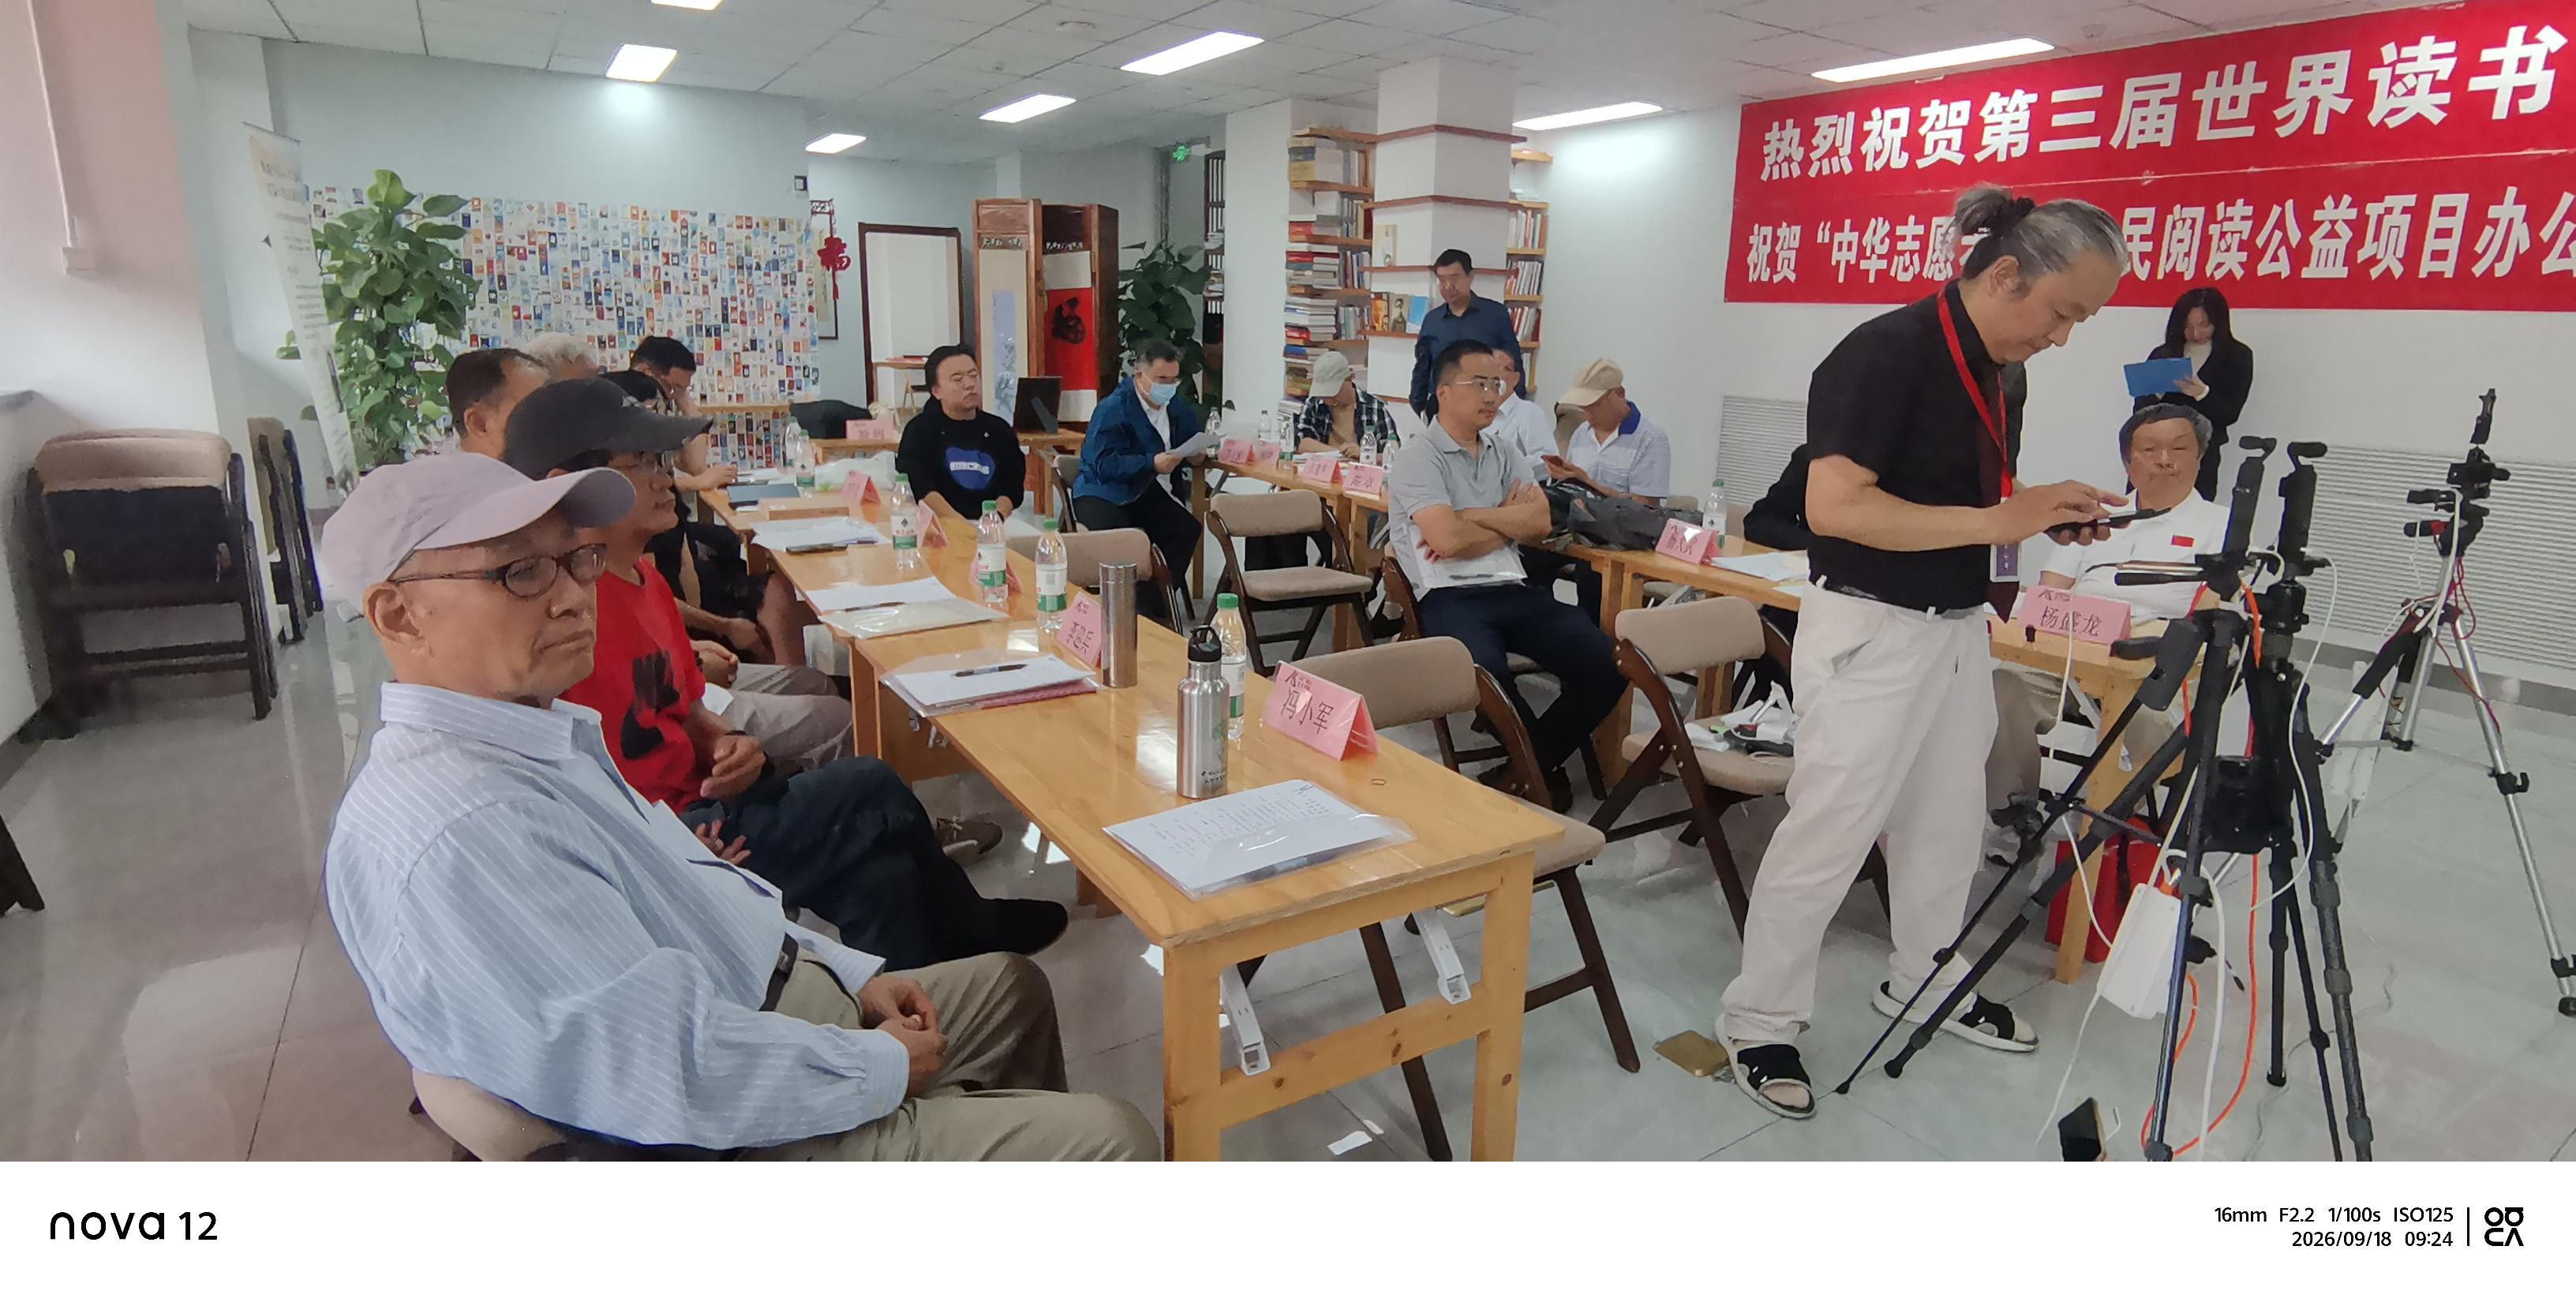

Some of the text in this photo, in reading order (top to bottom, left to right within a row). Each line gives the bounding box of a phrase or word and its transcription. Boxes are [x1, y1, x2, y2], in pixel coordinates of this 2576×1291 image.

[1761, 24, 2568, 181] 热烈祝贺第三届世界读书
